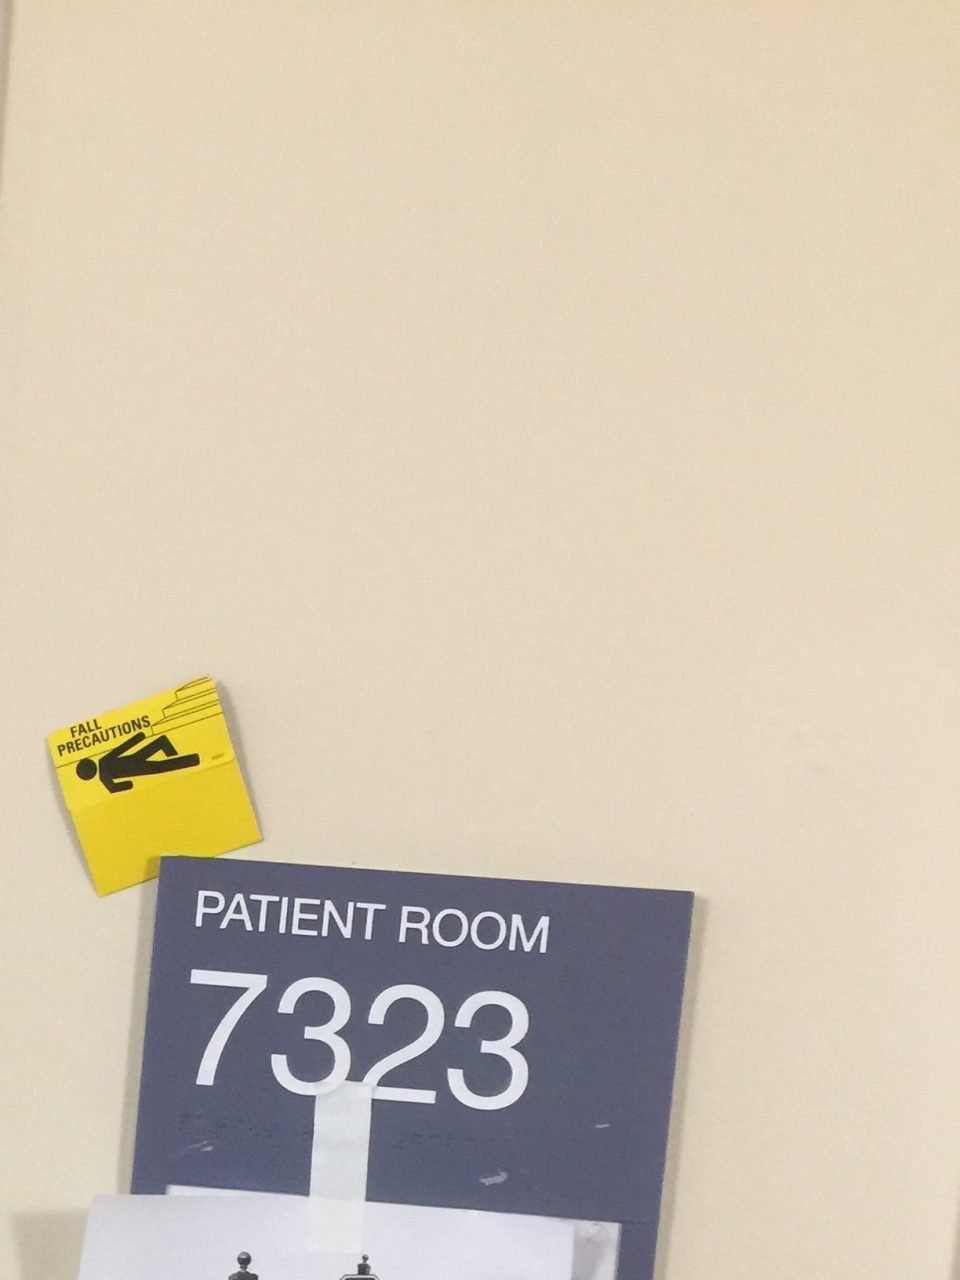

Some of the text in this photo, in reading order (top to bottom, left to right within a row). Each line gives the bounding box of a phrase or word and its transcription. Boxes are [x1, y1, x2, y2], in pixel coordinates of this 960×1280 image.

[57, 715, 151, 757] PRECAUTIONS
[69, 718, 102, 738] FALL
[194, 889, 551, 954] PATIENT ROOM
[189, 968, 530, 1111] 7323
